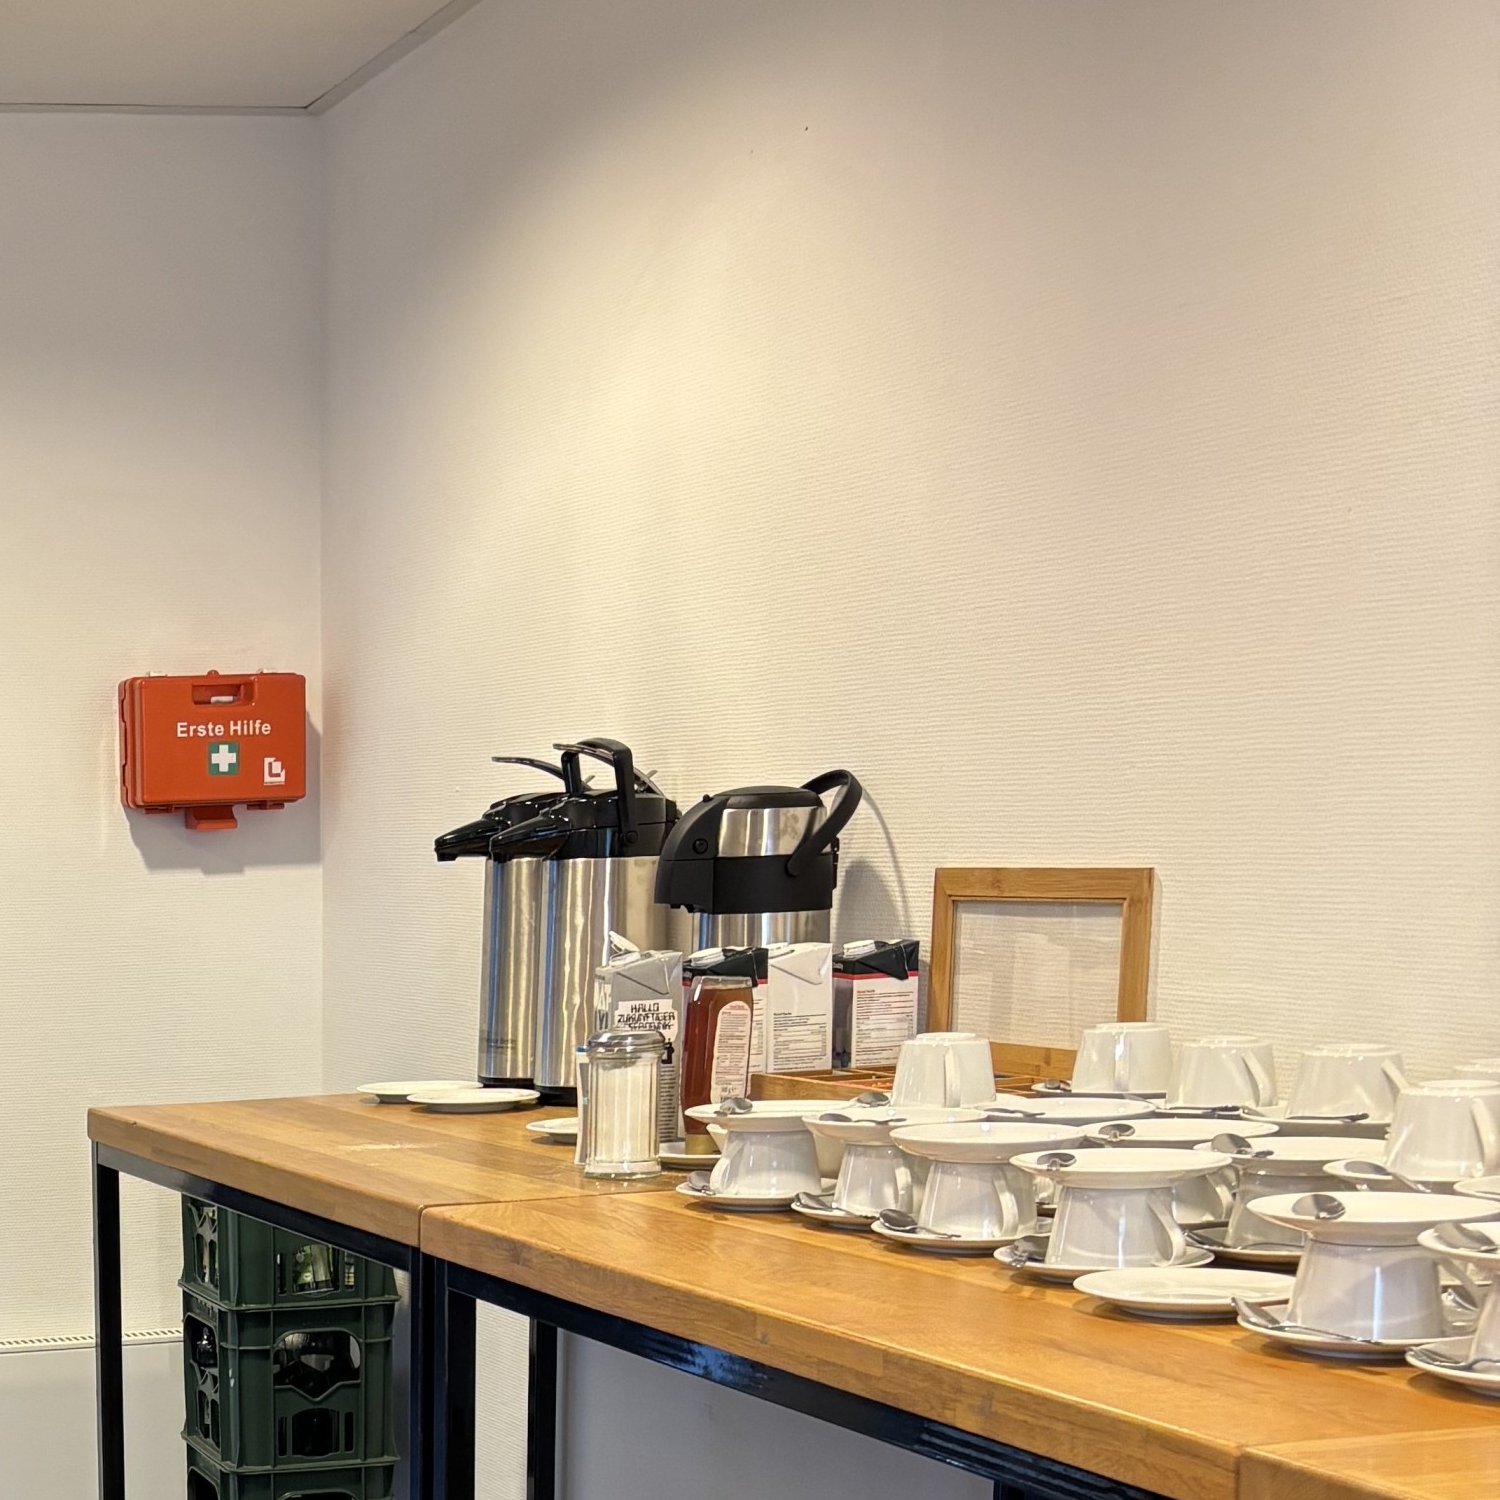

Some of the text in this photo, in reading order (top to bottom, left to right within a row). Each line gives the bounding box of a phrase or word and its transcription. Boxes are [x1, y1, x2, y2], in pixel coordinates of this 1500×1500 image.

[176, 719, 272, 738] Erste Hilfe
[630, 1002, 660, 1014] HALLO
